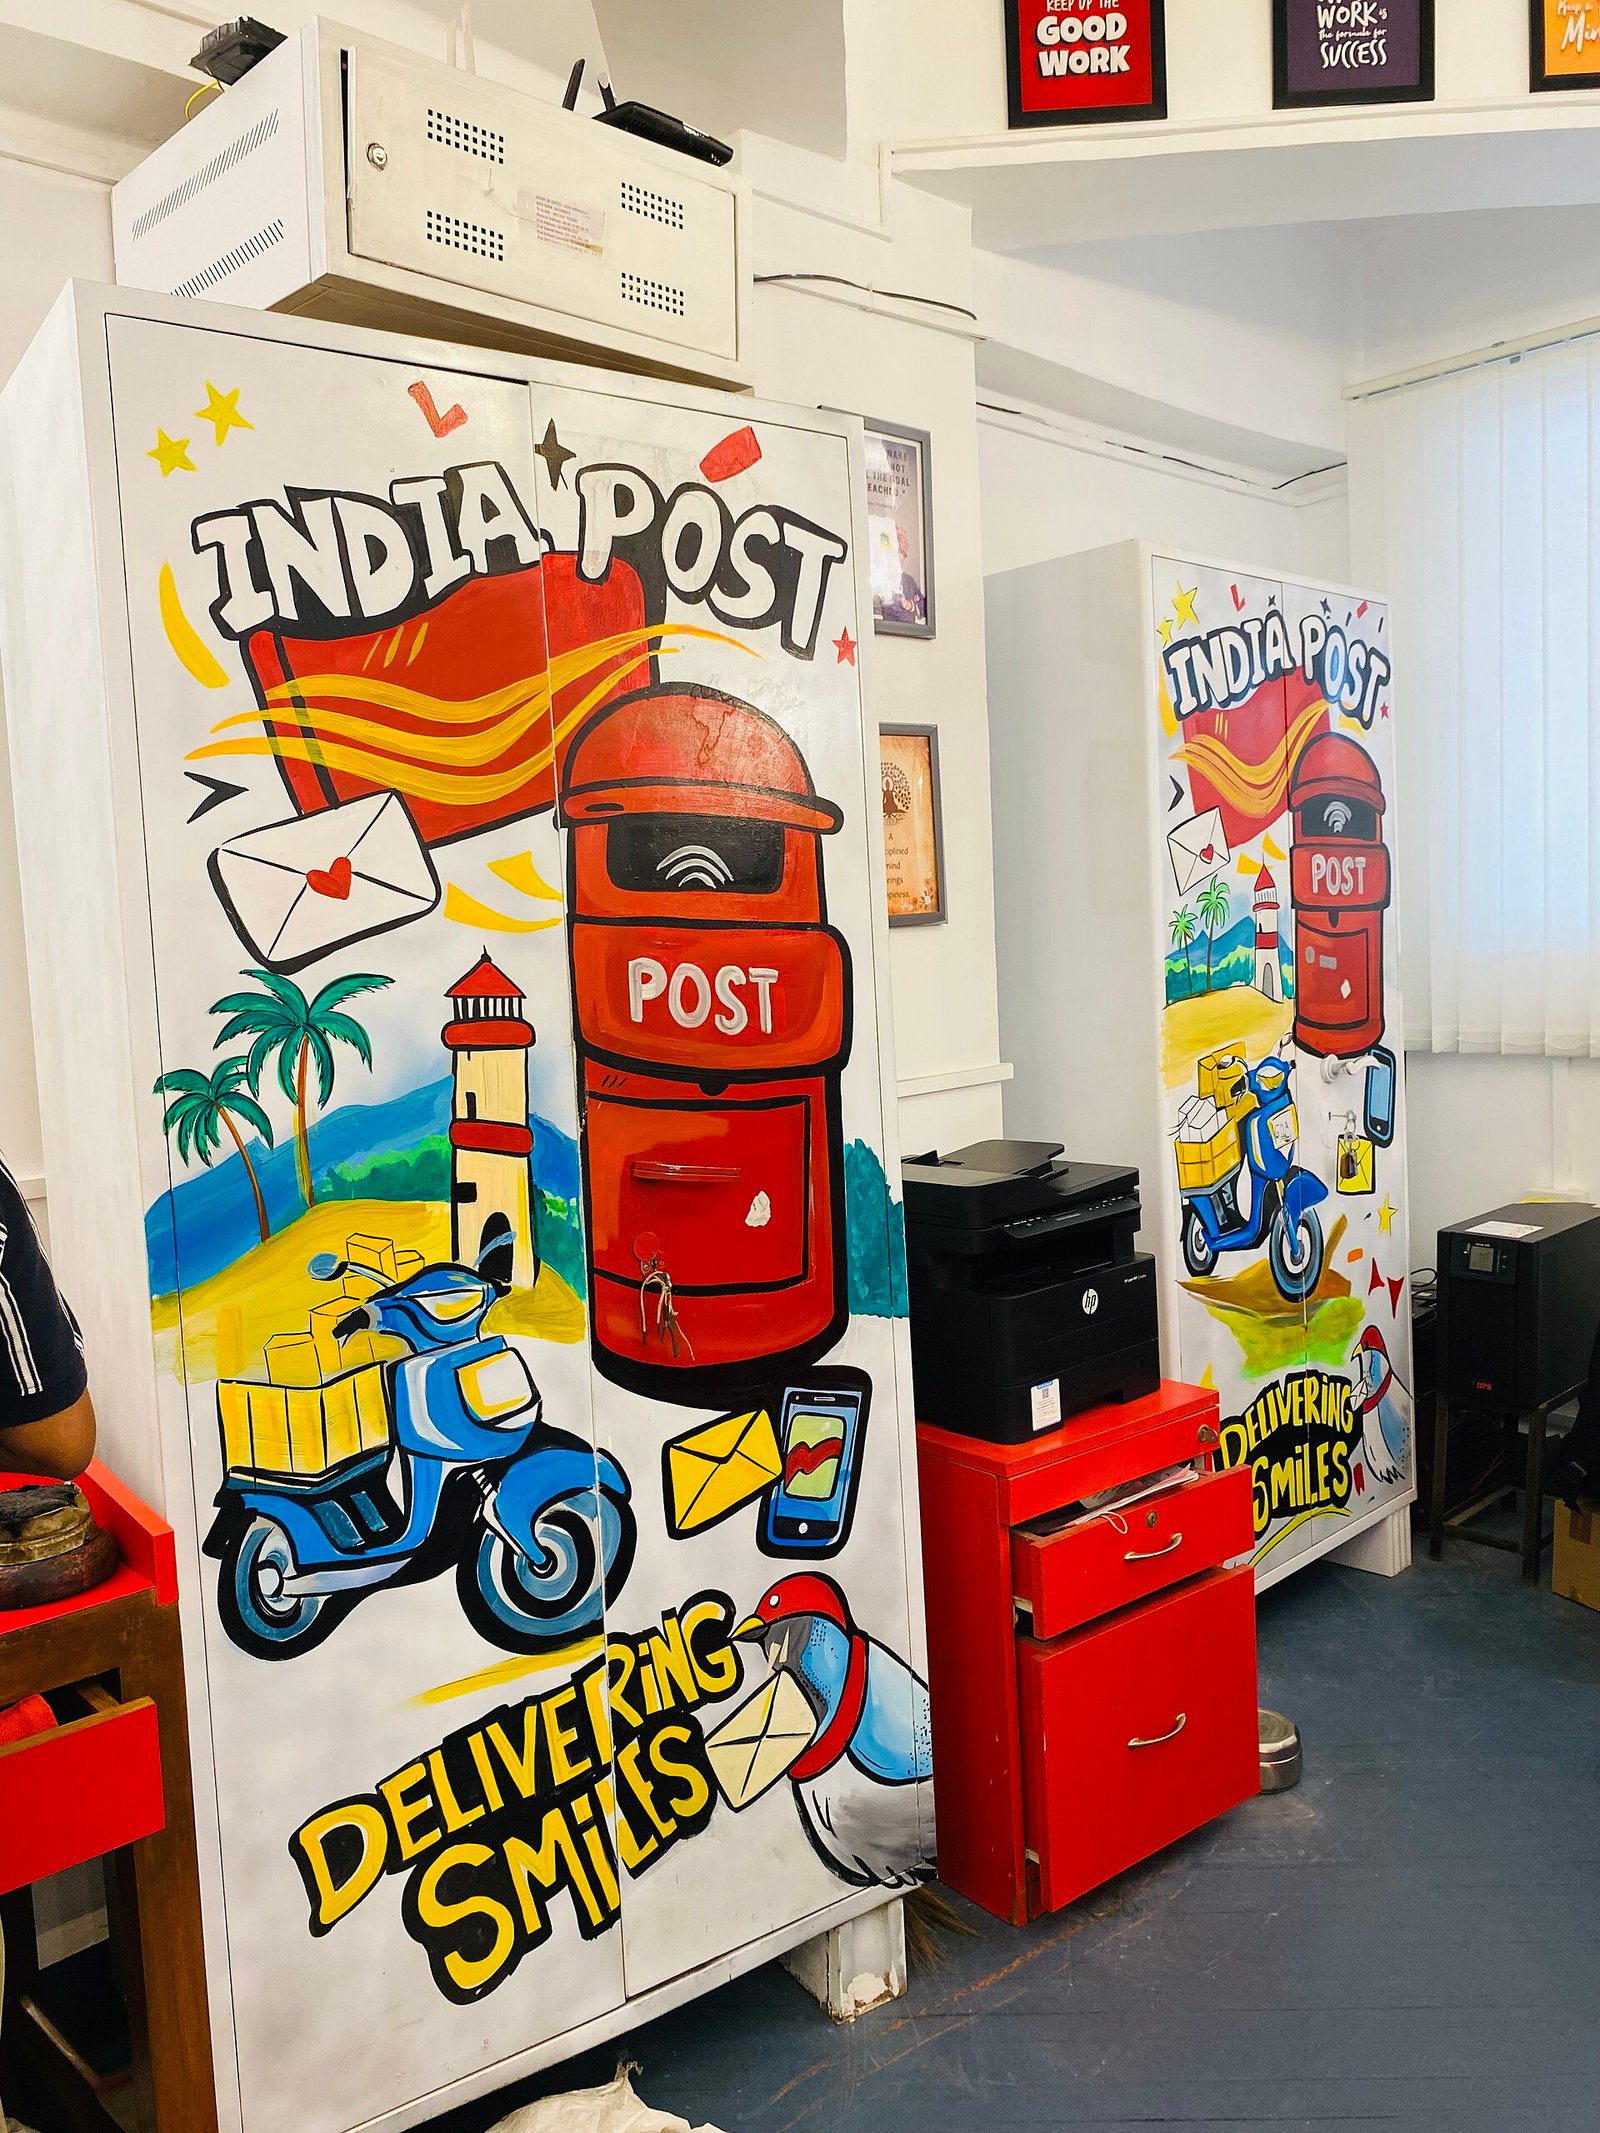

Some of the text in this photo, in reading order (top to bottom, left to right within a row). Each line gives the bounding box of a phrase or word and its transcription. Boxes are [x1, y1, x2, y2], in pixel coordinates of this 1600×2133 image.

[1037, 12, 1127, 46] GOOD
[1316, 1, 1378, 29] WORK
[1318, 28, 1334, 40] the
[1373, 28, 1387, 39] for
[1039, 45, 1131, 77] WORK
[1320, 38, 1387, 69] SUCCESS
[193, 462, 847, 660] INDIA POST
[1165, 611, 1389, 728] INDIA POST
[888, 833, 894, 841] A
[1311, 853, 1367, 896] POST
[628, 957, 779, 1036] POST
[1083, 1289, 1097, 1314] hp
[1219, 1375, 1353, 1471] DELIVERING
[296, 1596, 742, 1930] DELIVERING
[410, 1718, 714, 1996] SMILES
